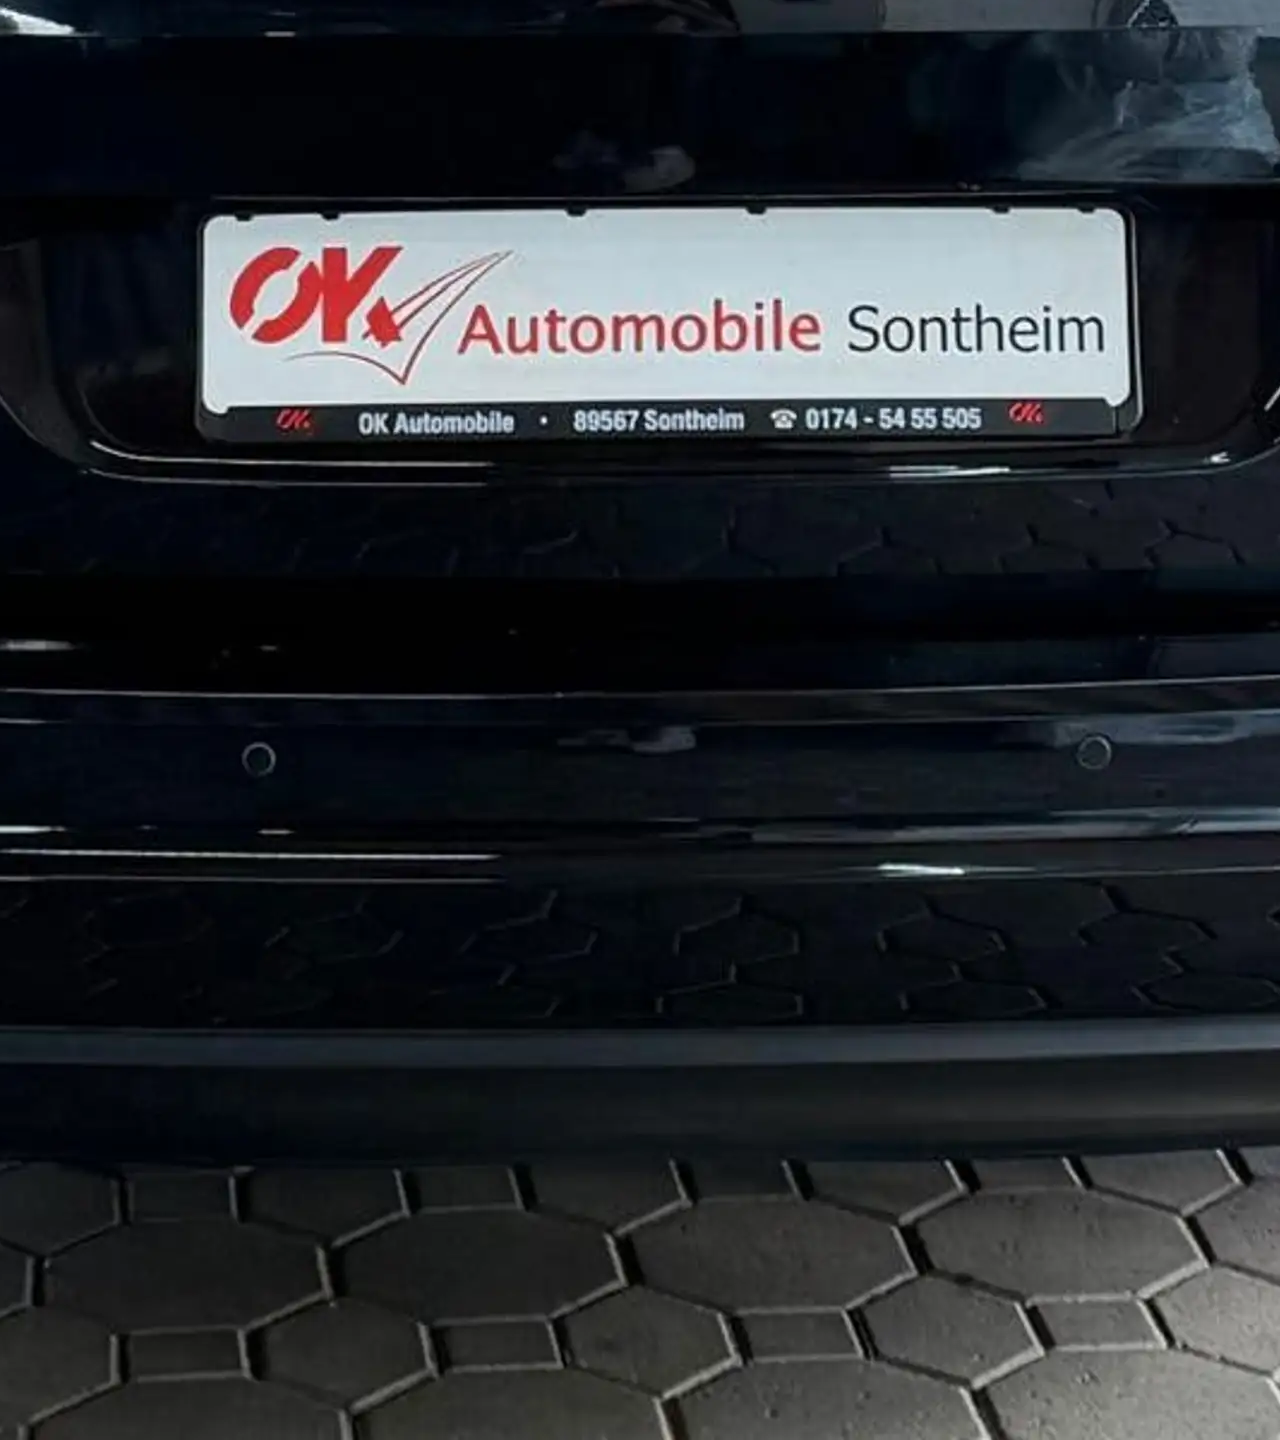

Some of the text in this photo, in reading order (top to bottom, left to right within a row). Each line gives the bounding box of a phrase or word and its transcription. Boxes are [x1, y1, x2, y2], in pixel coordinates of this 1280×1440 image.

[229, 246, 1105, 356] OK Automobile Sontheim
[358, 412, 390, 436] OK
[393, 410, 516, 435] Automobile
[573, 409, 640, 432] 89567
[643, 407, 745, 431] Sontheim
[804, 407, 858, 430] 0174
[878, 408, 906, 429] 54
[910, 408, 938, 429] 55
[941, 407, 983, 429] 505
